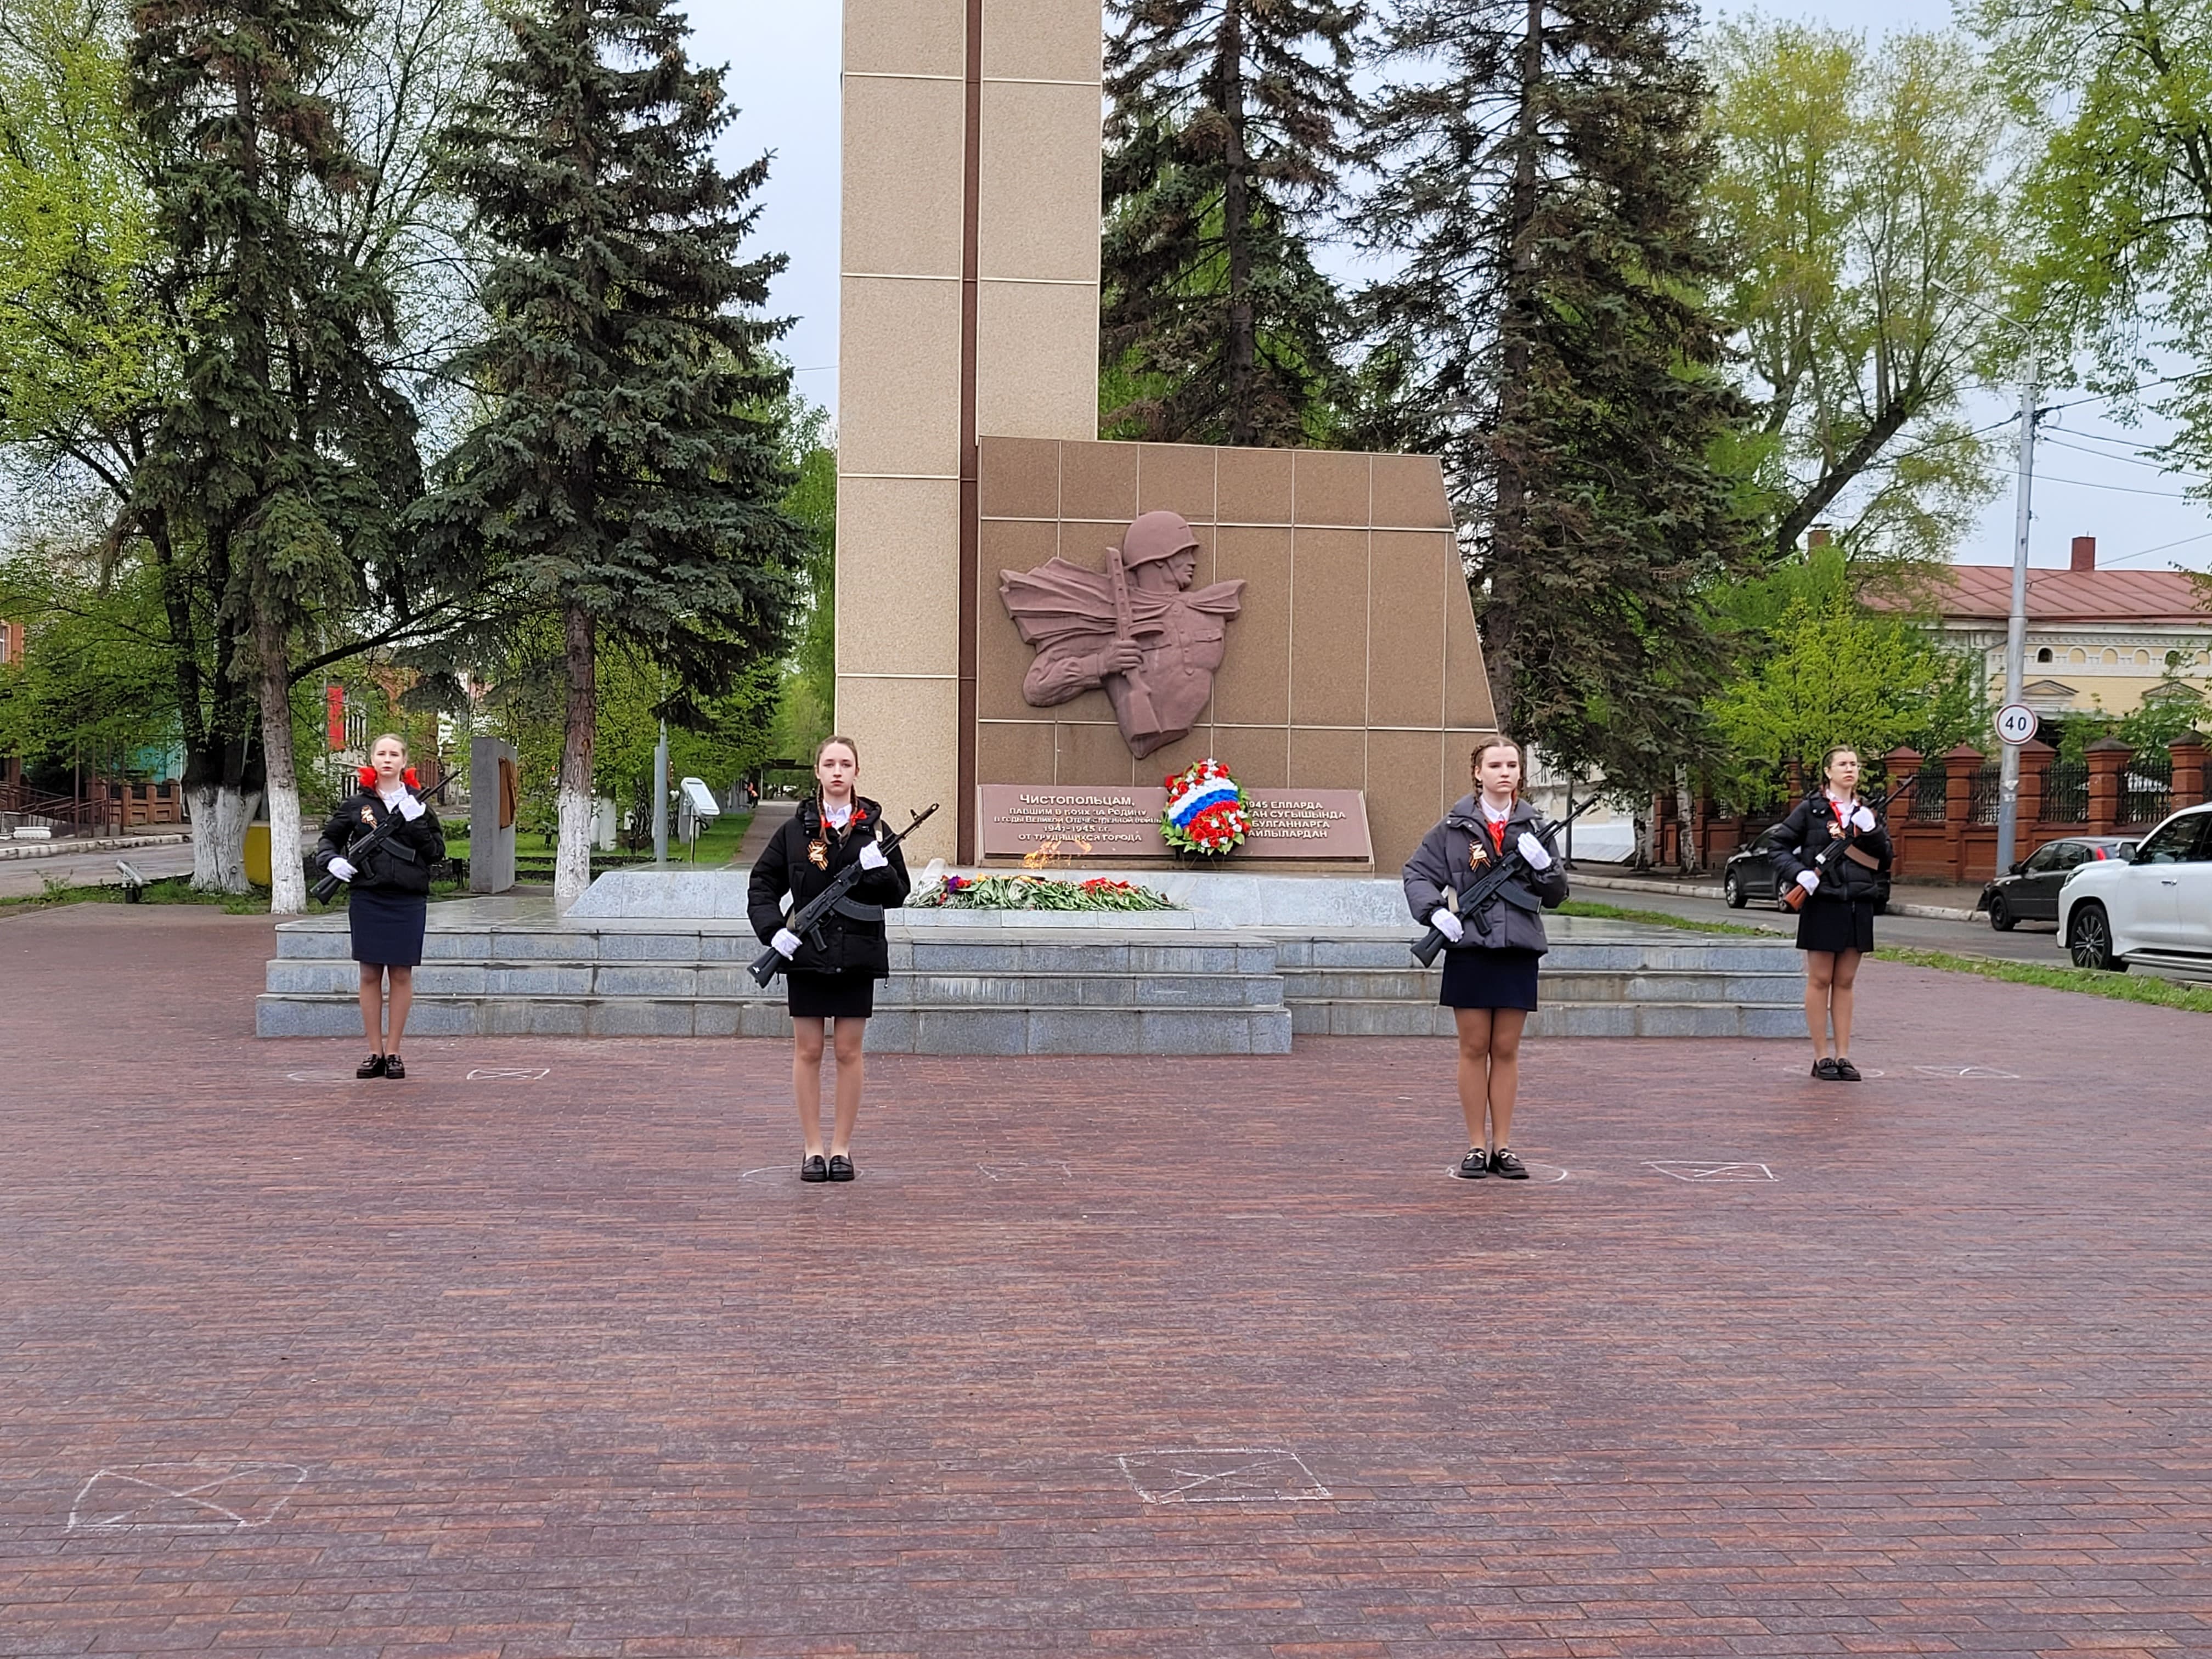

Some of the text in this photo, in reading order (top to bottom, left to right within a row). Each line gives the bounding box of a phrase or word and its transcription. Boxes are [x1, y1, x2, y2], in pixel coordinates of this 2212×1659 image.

[2005, 716, 2027, 731] 40
[1271, 801, 1324, 810] ЕЛЛАРДА
[1270, 810, 1346, 820] СУГЫШЫНДА
[1251, 820, 1330, 828] БУЛГАННАРГА
[1102, 834, 1142, 842] ГОРОДА
